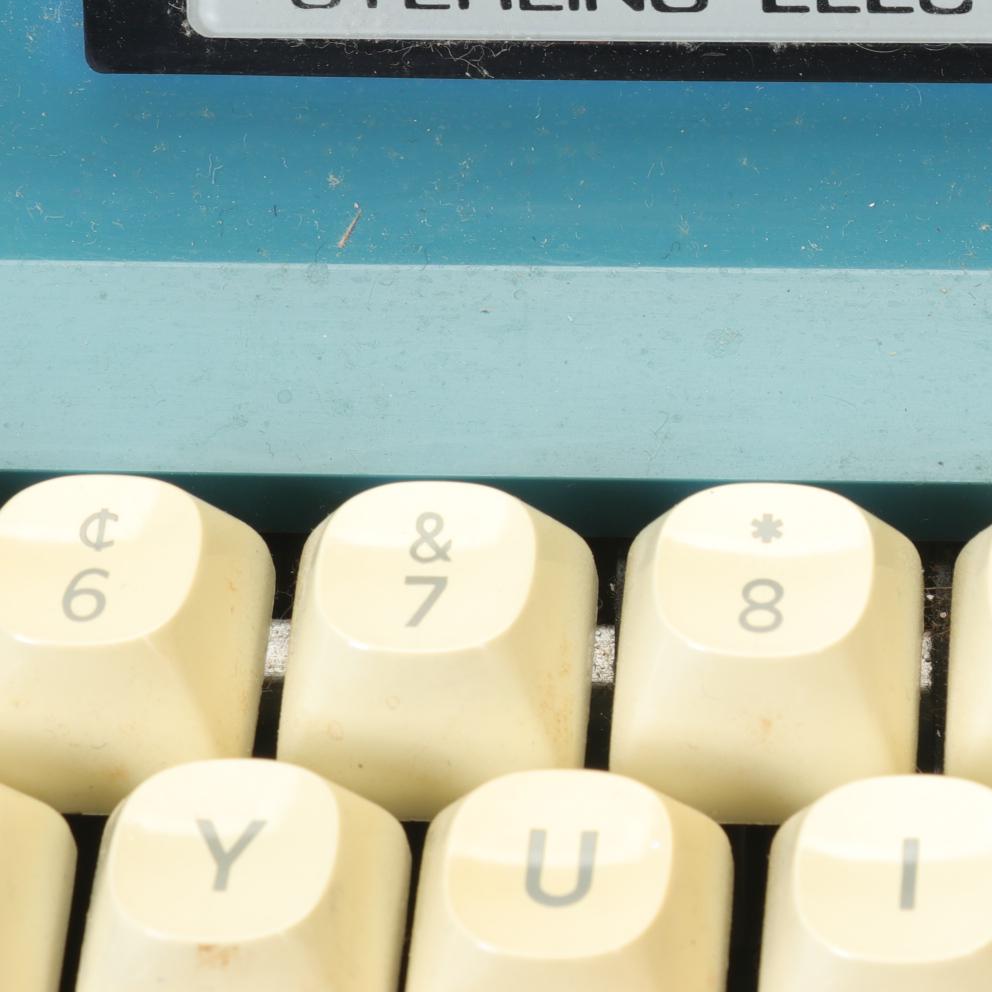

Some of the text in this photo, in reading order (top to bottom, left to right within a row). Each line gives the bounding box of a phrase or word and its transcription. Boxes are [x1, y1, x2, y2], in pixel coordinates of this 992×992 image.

[409, 512, 453, 564] &
[61, 568, 111, 623] 6
[403, 575, 449, 628] 7
[738, 578, 785, 634] 8
[195, 819, 268, 892] Y
[524, 829, 599, 907] U
[899, 837, 920, 911] I
